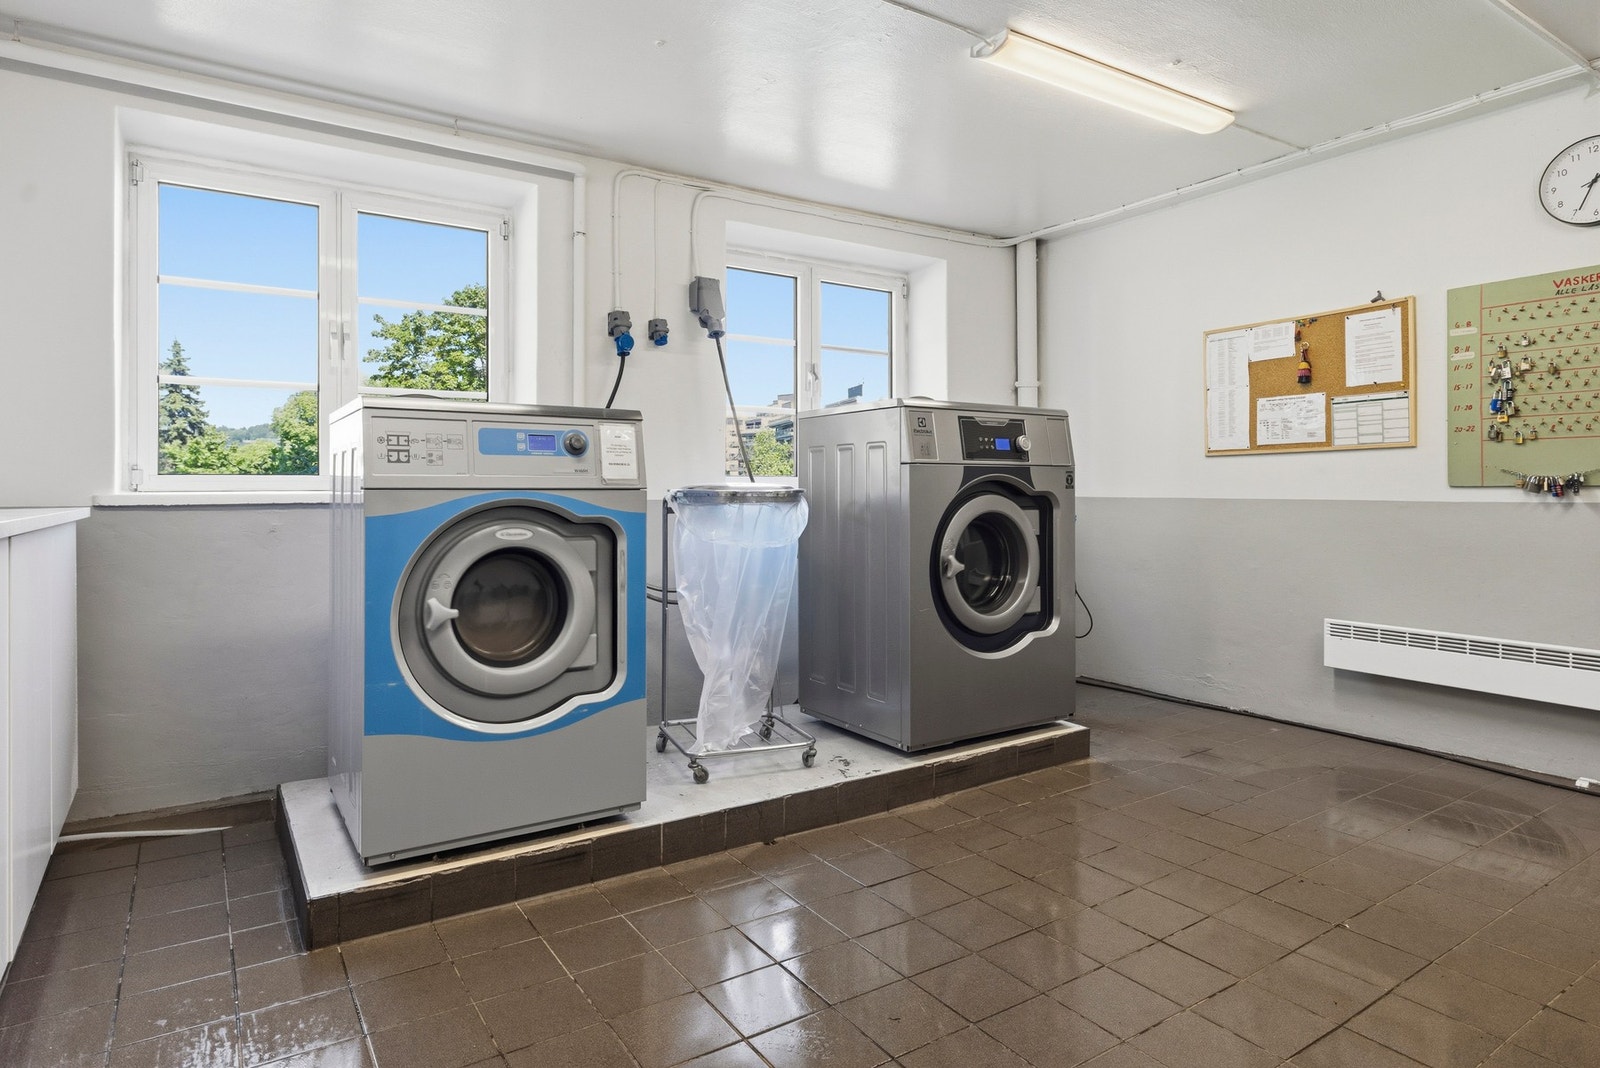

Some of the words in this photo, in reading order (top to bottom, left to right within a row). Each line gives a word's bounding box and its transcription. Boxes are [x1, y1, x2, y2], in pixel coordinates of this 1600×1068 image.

[1588, 144, 1599, 154] 12
[1571, 154, 1581, 162] 11
[1557, 168, 1568, 177] 10
[1572, 208, 1578, 216] 7
[1593, 208, 1599, 216] 6
[1555, 288, 1577, 296] ALLE
